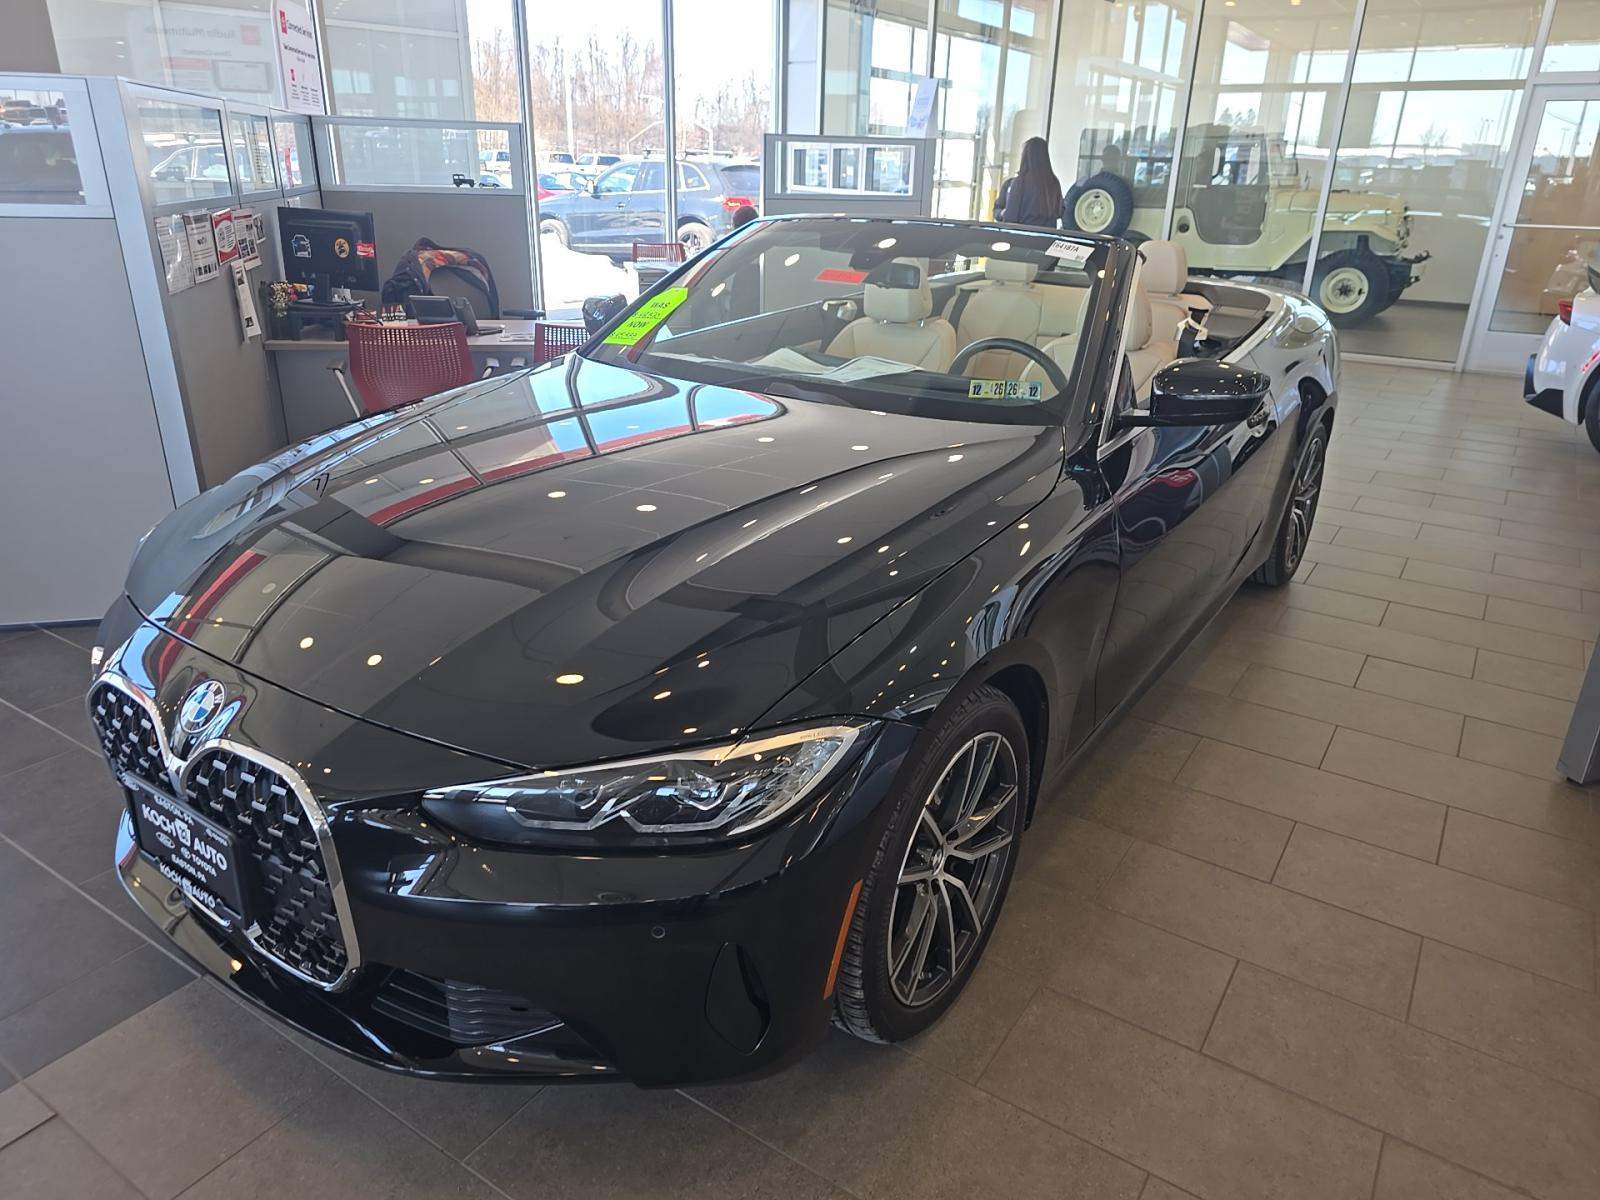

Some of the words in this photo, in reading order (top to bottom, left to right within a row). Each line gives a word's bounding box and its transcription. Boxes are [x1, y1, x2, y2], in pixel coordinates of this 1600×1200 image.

[972, 384, 981, 396] 12
[994, 382, 1004, 396] 26
[1008, 382, 1018, 396] 26
[1029, 385, 1038, 398] 12
[141, 803, 177, 837] KOCH
[193, 837, 228, 871] AUTO
